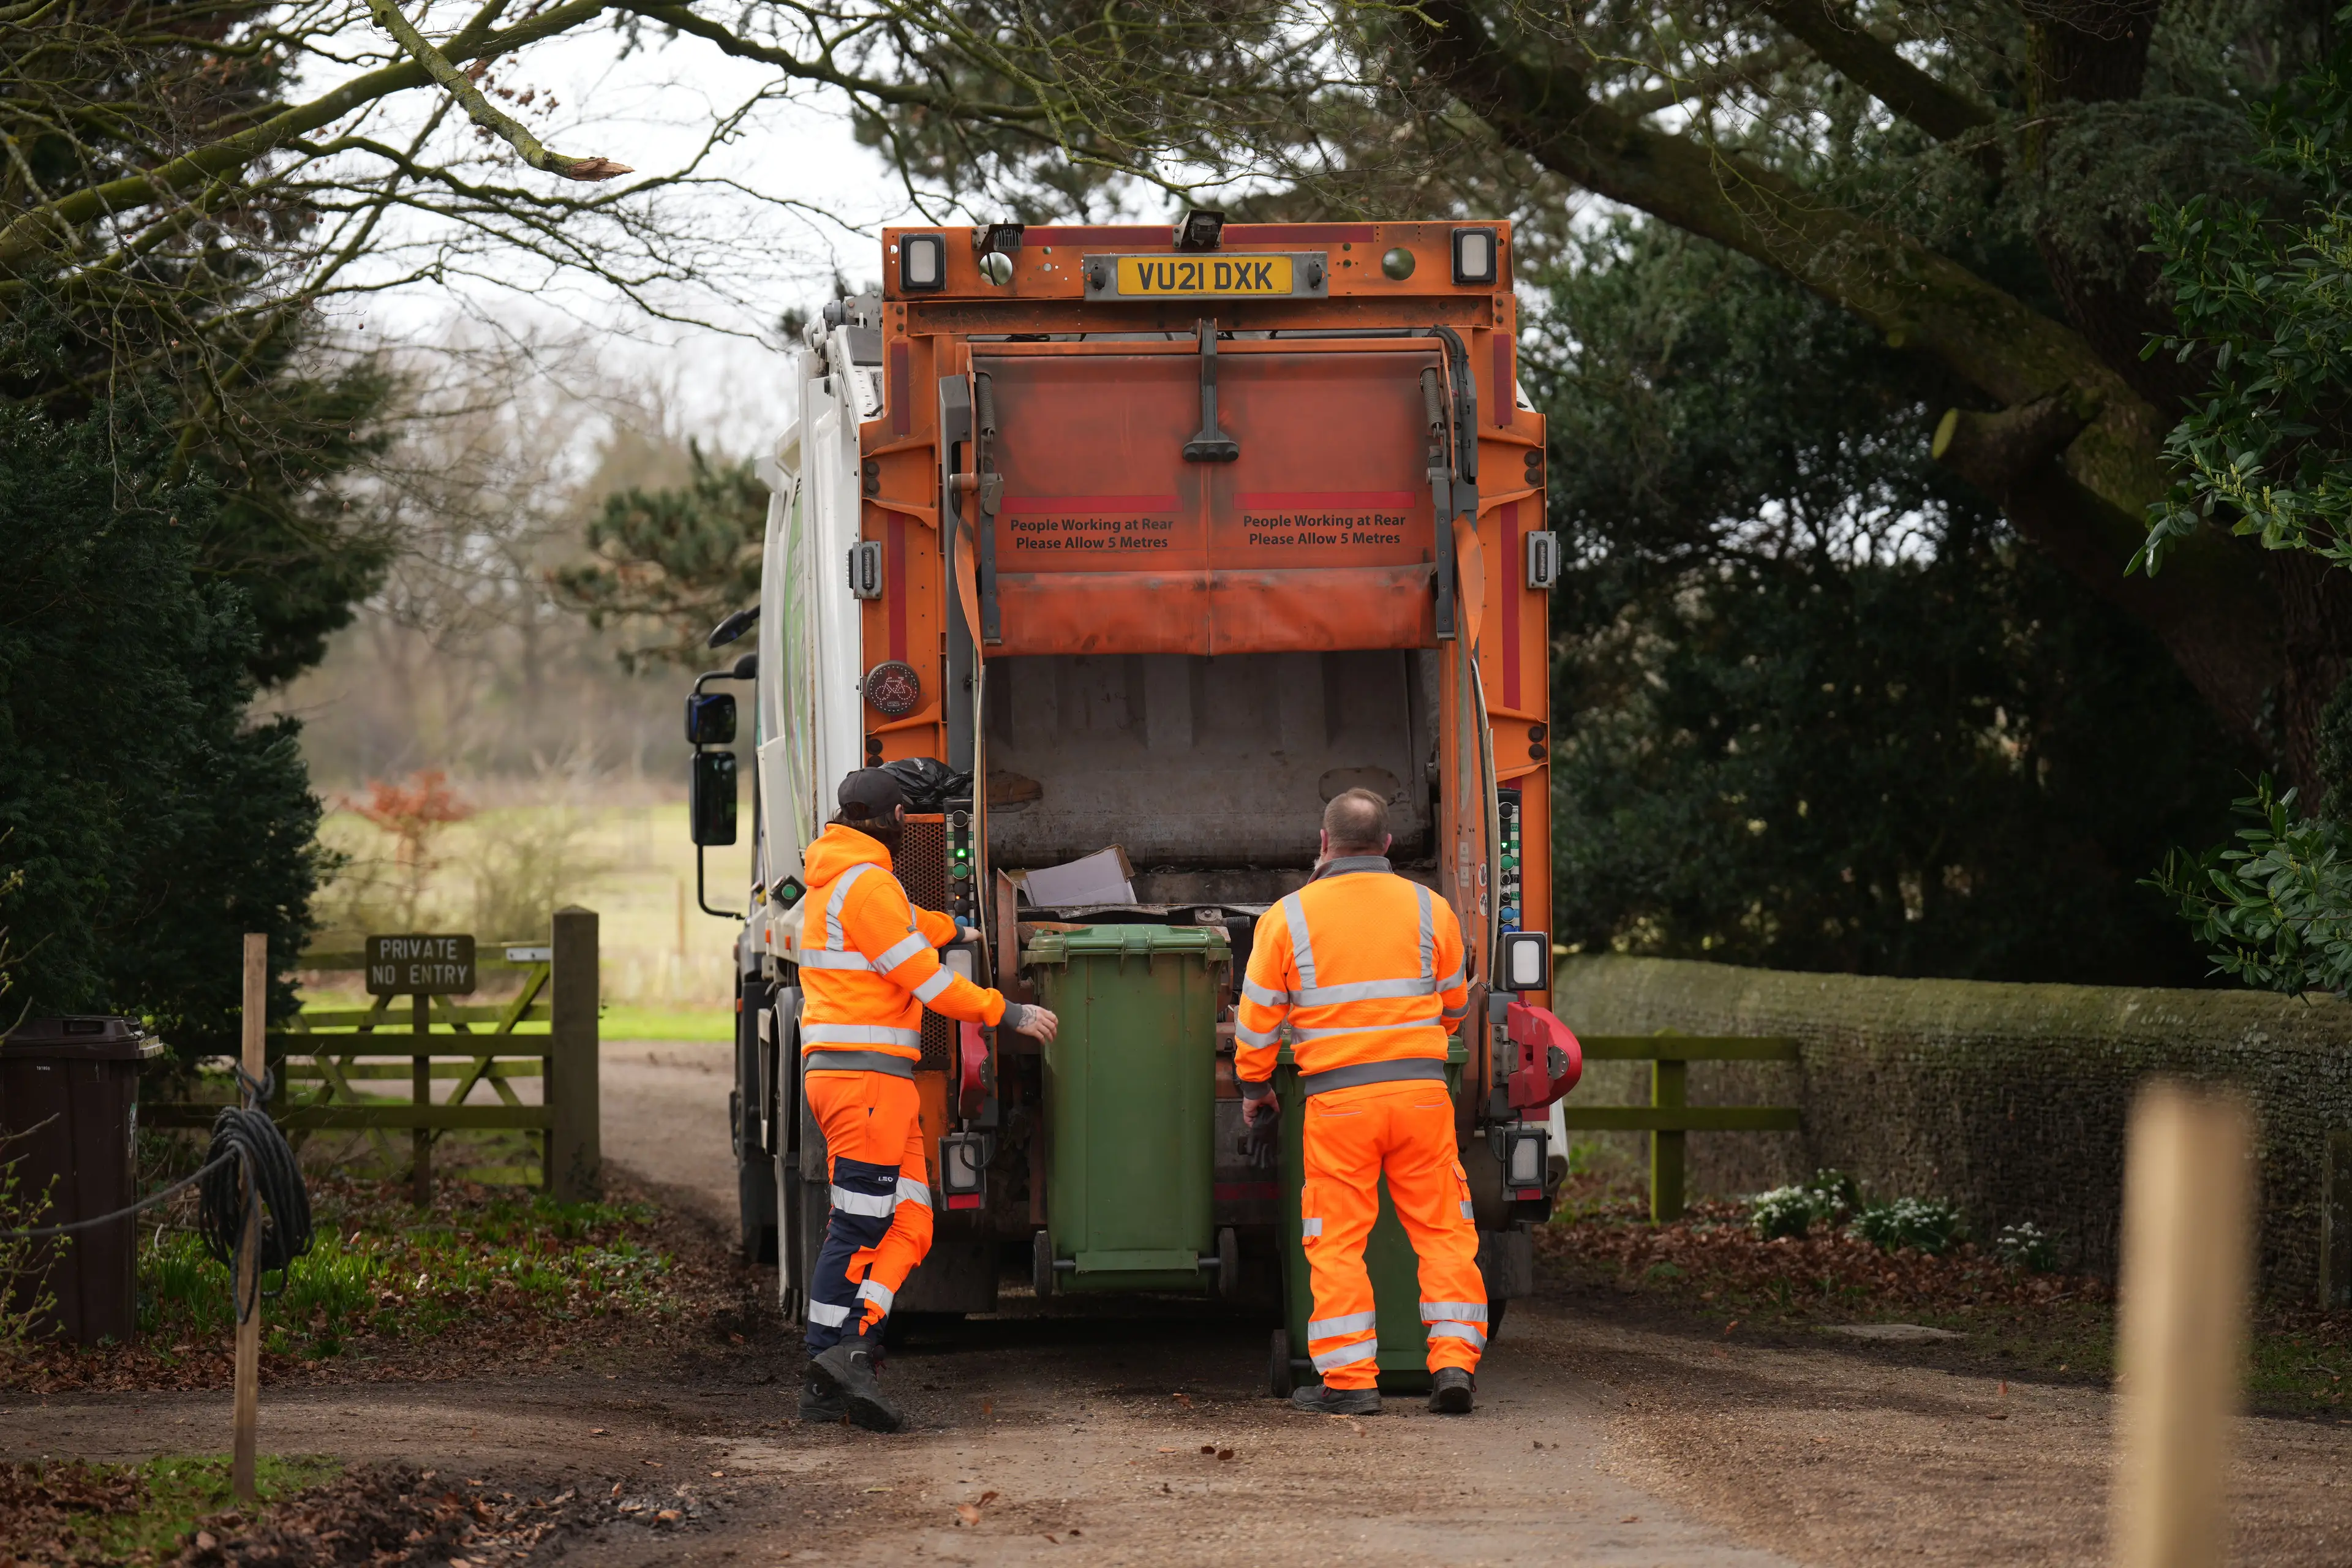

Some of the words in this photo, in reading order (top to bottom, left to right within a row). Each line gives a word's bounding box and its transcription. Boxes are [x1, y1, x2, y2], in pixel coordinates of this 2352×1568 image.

[1137, 262, 1204, 290] VU21
[1214, 262, 1272, 290] DXK
[1011, 519, 1058, 533] People
[1061, 518, 1121, 533] Working
[1125, 518, 1138, 530] at
[1142, 518, 1174, 530] Rear
[1243, 514, 1291, 530] People
[1294, 514, 1353, 529] Working
[1357, 514, 1371, 526] at
[1374, 514, 1406, 526] Rear
[1016, 537, 1061, 549] Please
[1065, 537, 1104, 548] Allow
[1108, 537, 1116, 548] 5
[1120, 536, 1168, 548] Metres
[1250, 532, 1294, 545] Please
[1297, 532, 1336, 545] Allow
[1341, 532, 1349, 544] 5
[1352, 532, 1400, 544] Metres
[380, 939, 458, 960] PRIVATE
[372, 965, 396, 985] NO
[409, 964, 468, 985] ENTRY
